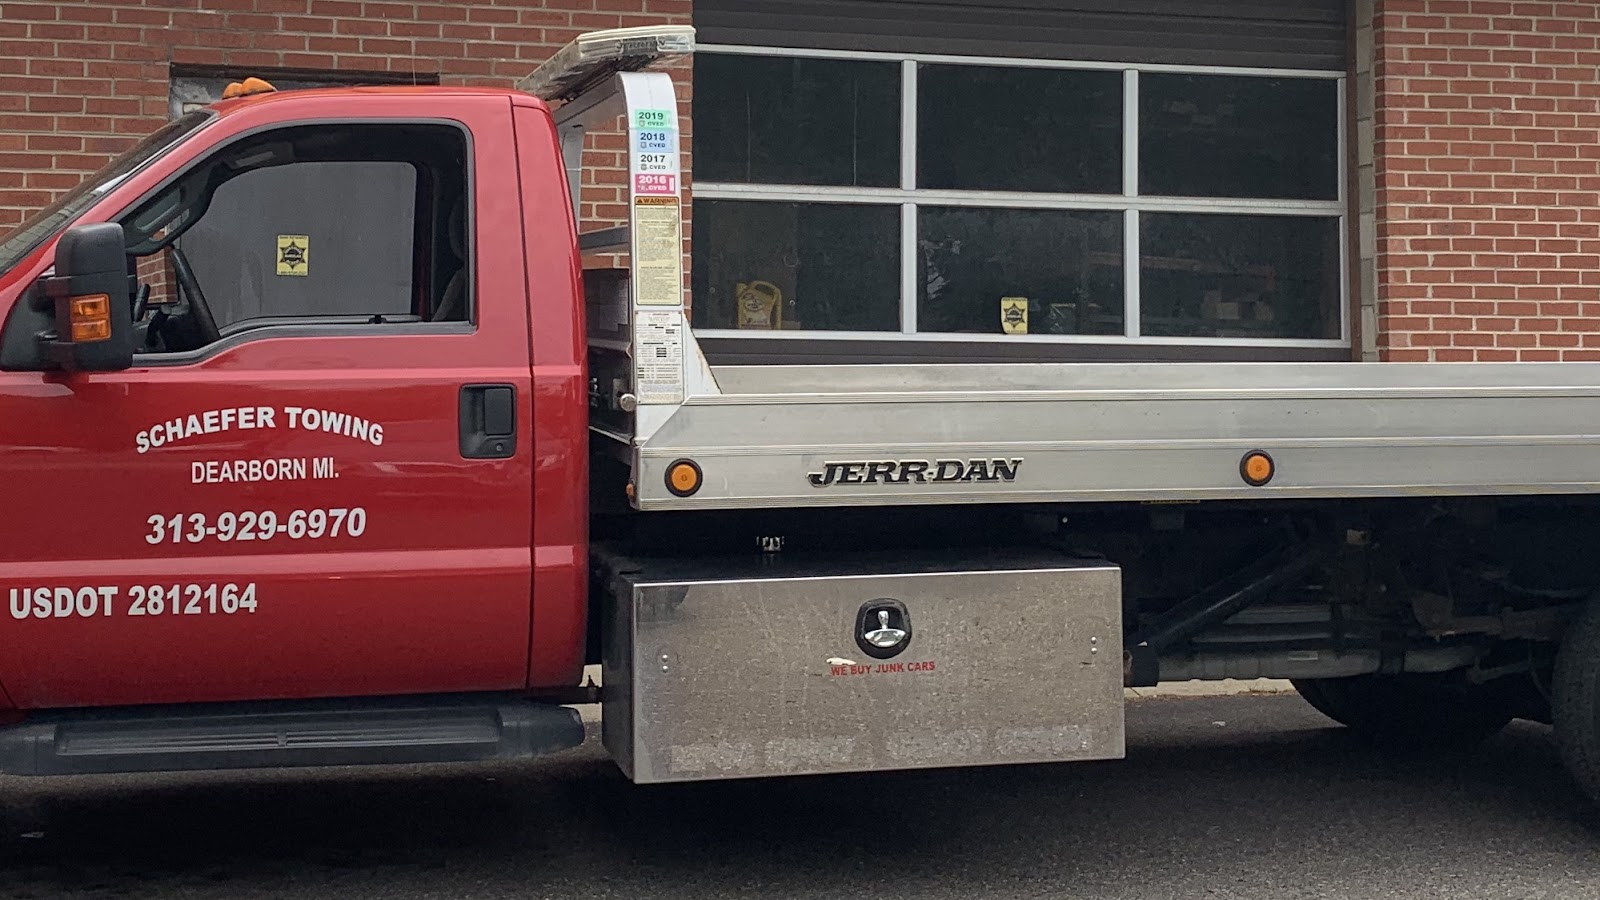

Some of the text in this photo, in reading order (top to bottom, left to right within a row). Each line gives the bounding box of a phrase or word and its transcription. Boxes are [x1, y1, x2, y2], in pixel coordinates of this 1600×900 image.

[638, 111, 664, 120] 2019
[640, 132, 665, 141] 2018
[640, 154, 666, 163] 2017
[638, 175, 667, 184] 2016
[135, 406, 384, 454] SCHAEFER TOWING
[191, 457, 340, 484] DEARBORN MI.
[806, 457, 1024, 488] JERR-DAN
[145, 507, 367, 545] 313-929-6970
[9, 583, 257, 619] USDOT 2812164
[831, 661, 935, 676] WE BUY JUNK CARS
